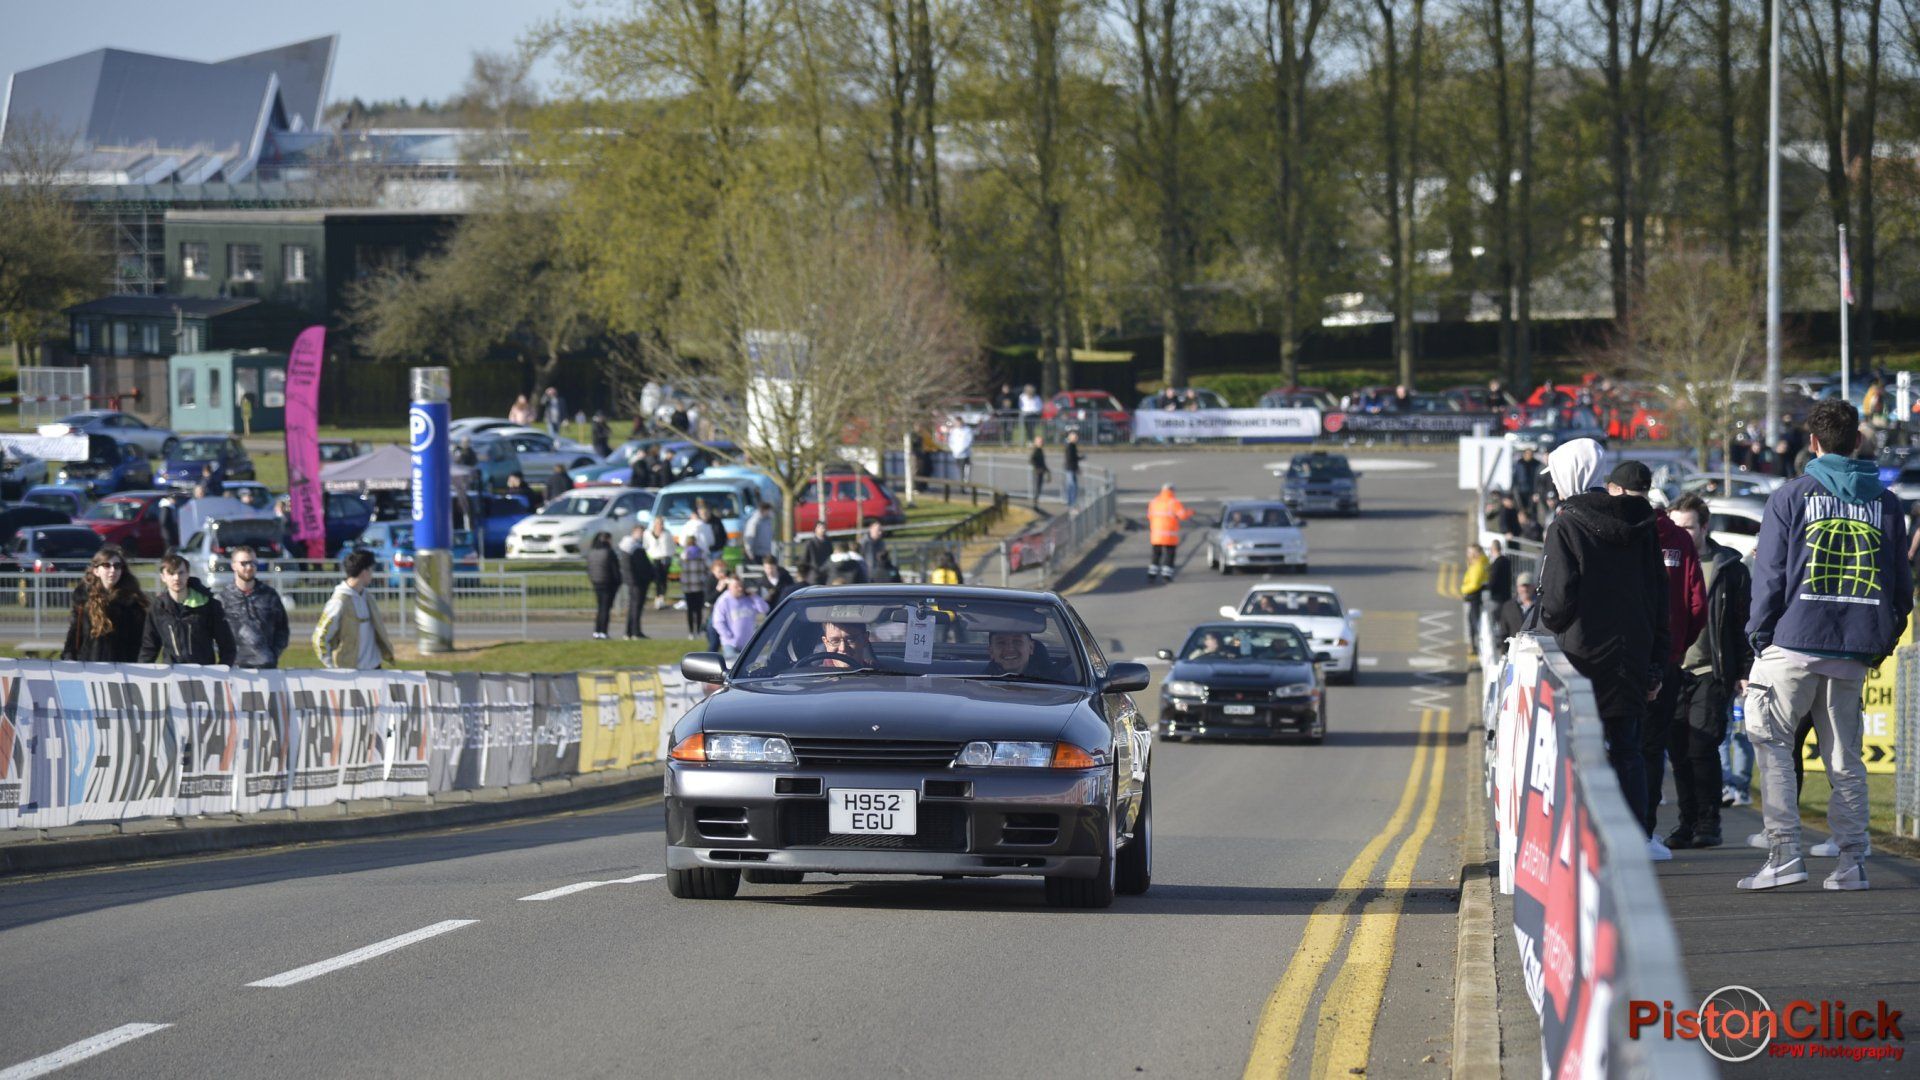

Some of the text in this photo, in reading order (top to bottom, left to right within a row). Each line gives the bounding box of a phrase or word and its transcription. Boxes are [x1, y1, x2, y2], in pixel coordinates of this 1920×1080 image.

[913, 633, 926, 646] B4
[844, 794, 901, 811] H952
[852, 813, 893, 830] EGU
